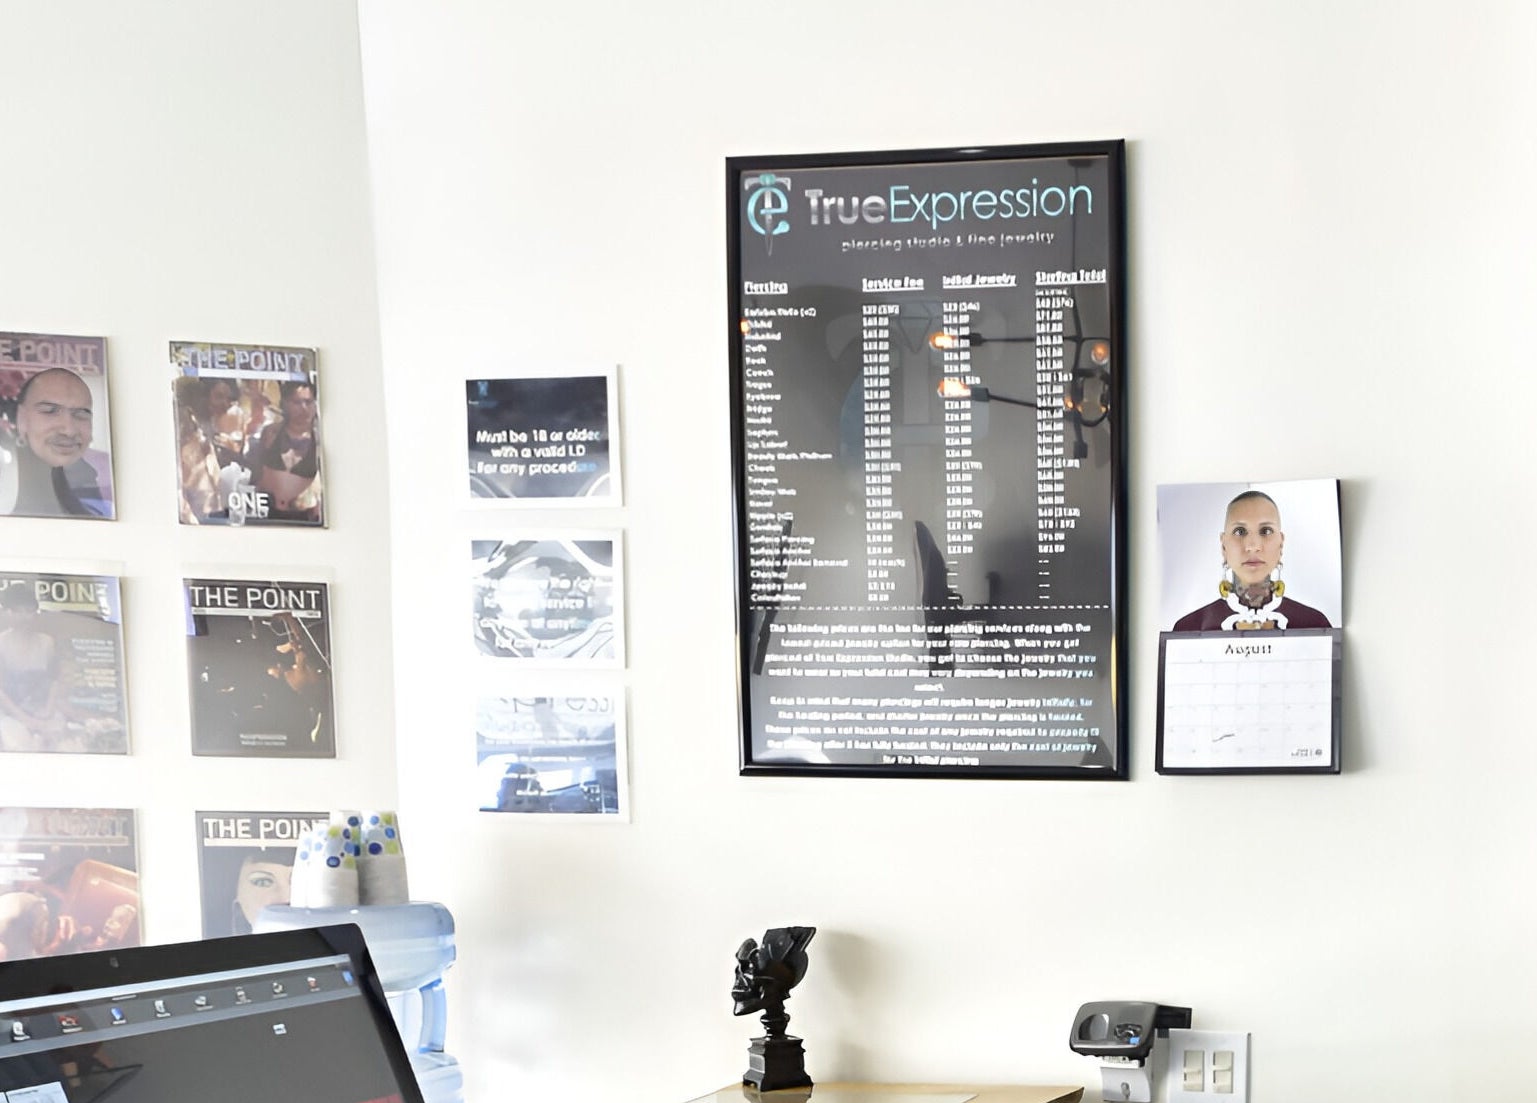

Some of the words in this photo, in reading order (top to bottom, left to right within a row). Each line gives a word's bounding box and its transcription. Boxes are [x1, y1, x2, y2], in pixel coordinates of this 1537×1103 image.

[907, 236, 950, 248] studio
[20, 341, 98, 366] POINT
[184, 347, 229, 369] THE
[235, 350, 305, 373] POINT
[509, 430, 527, 443] be
[491, 446, 518, 457] with
[521, 448, 531, 458] a
[500, 463, 526, 476] any
[228, 491, 269, 512] ONE
[189, 586, 239, 607] THE
[246, 588, 321, 611] POINT
[203, 818, 252, 838] THE
[259, 819, 329, 839] POIN
